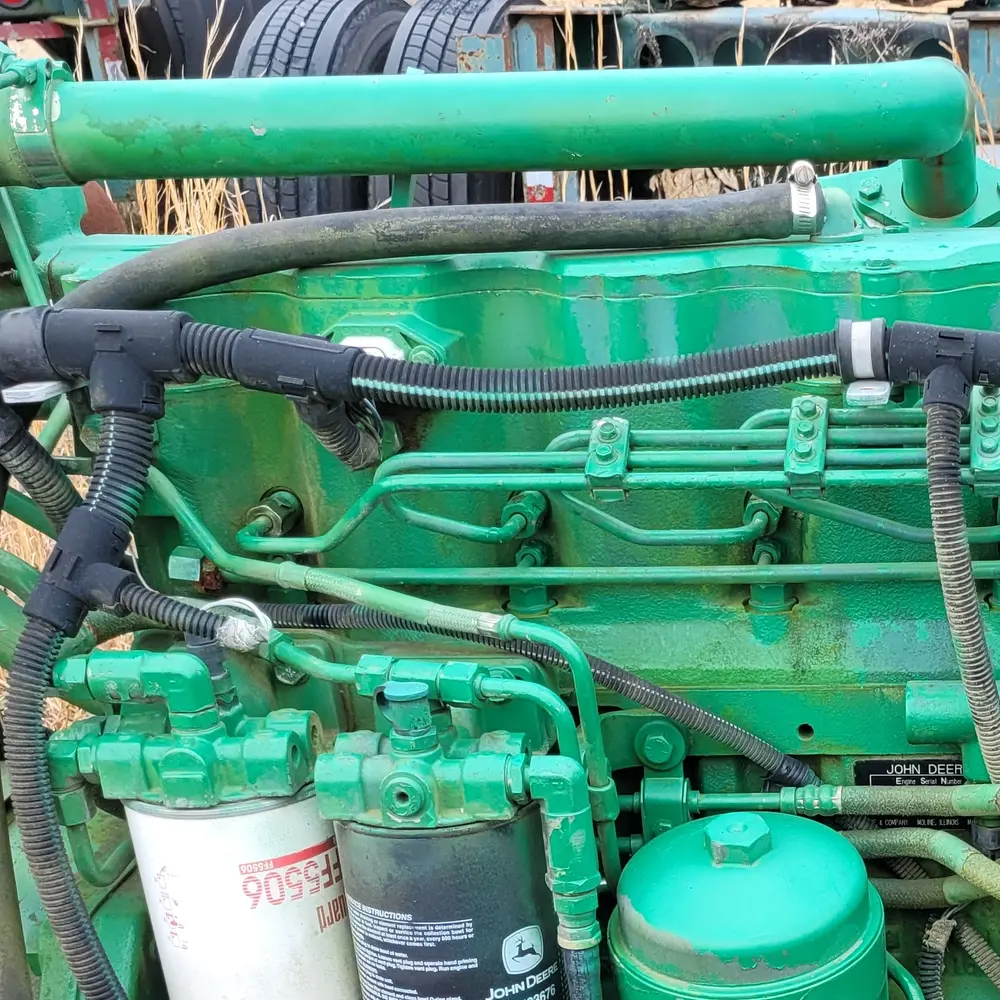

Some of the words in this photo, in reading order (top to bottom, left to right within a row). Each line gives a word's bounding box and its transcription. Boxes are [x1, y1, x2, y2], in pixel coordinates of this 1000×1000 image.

[887, 764, 921, 775] JOHN
[928, 764, 963, 775] DEER
[896, 777, 916, 786] Engine
[920, 777, 937, 785] Serial
[941, 777, 962, 785] Number
[240, 859, 274, 874] FF5506
[242, 848, 343, 909] FF5506
[316, 894, 347, 933] uard
[362, 904, 413, 921] INSTRUCTIONS
[525, 961, 559, 989] DEERE
